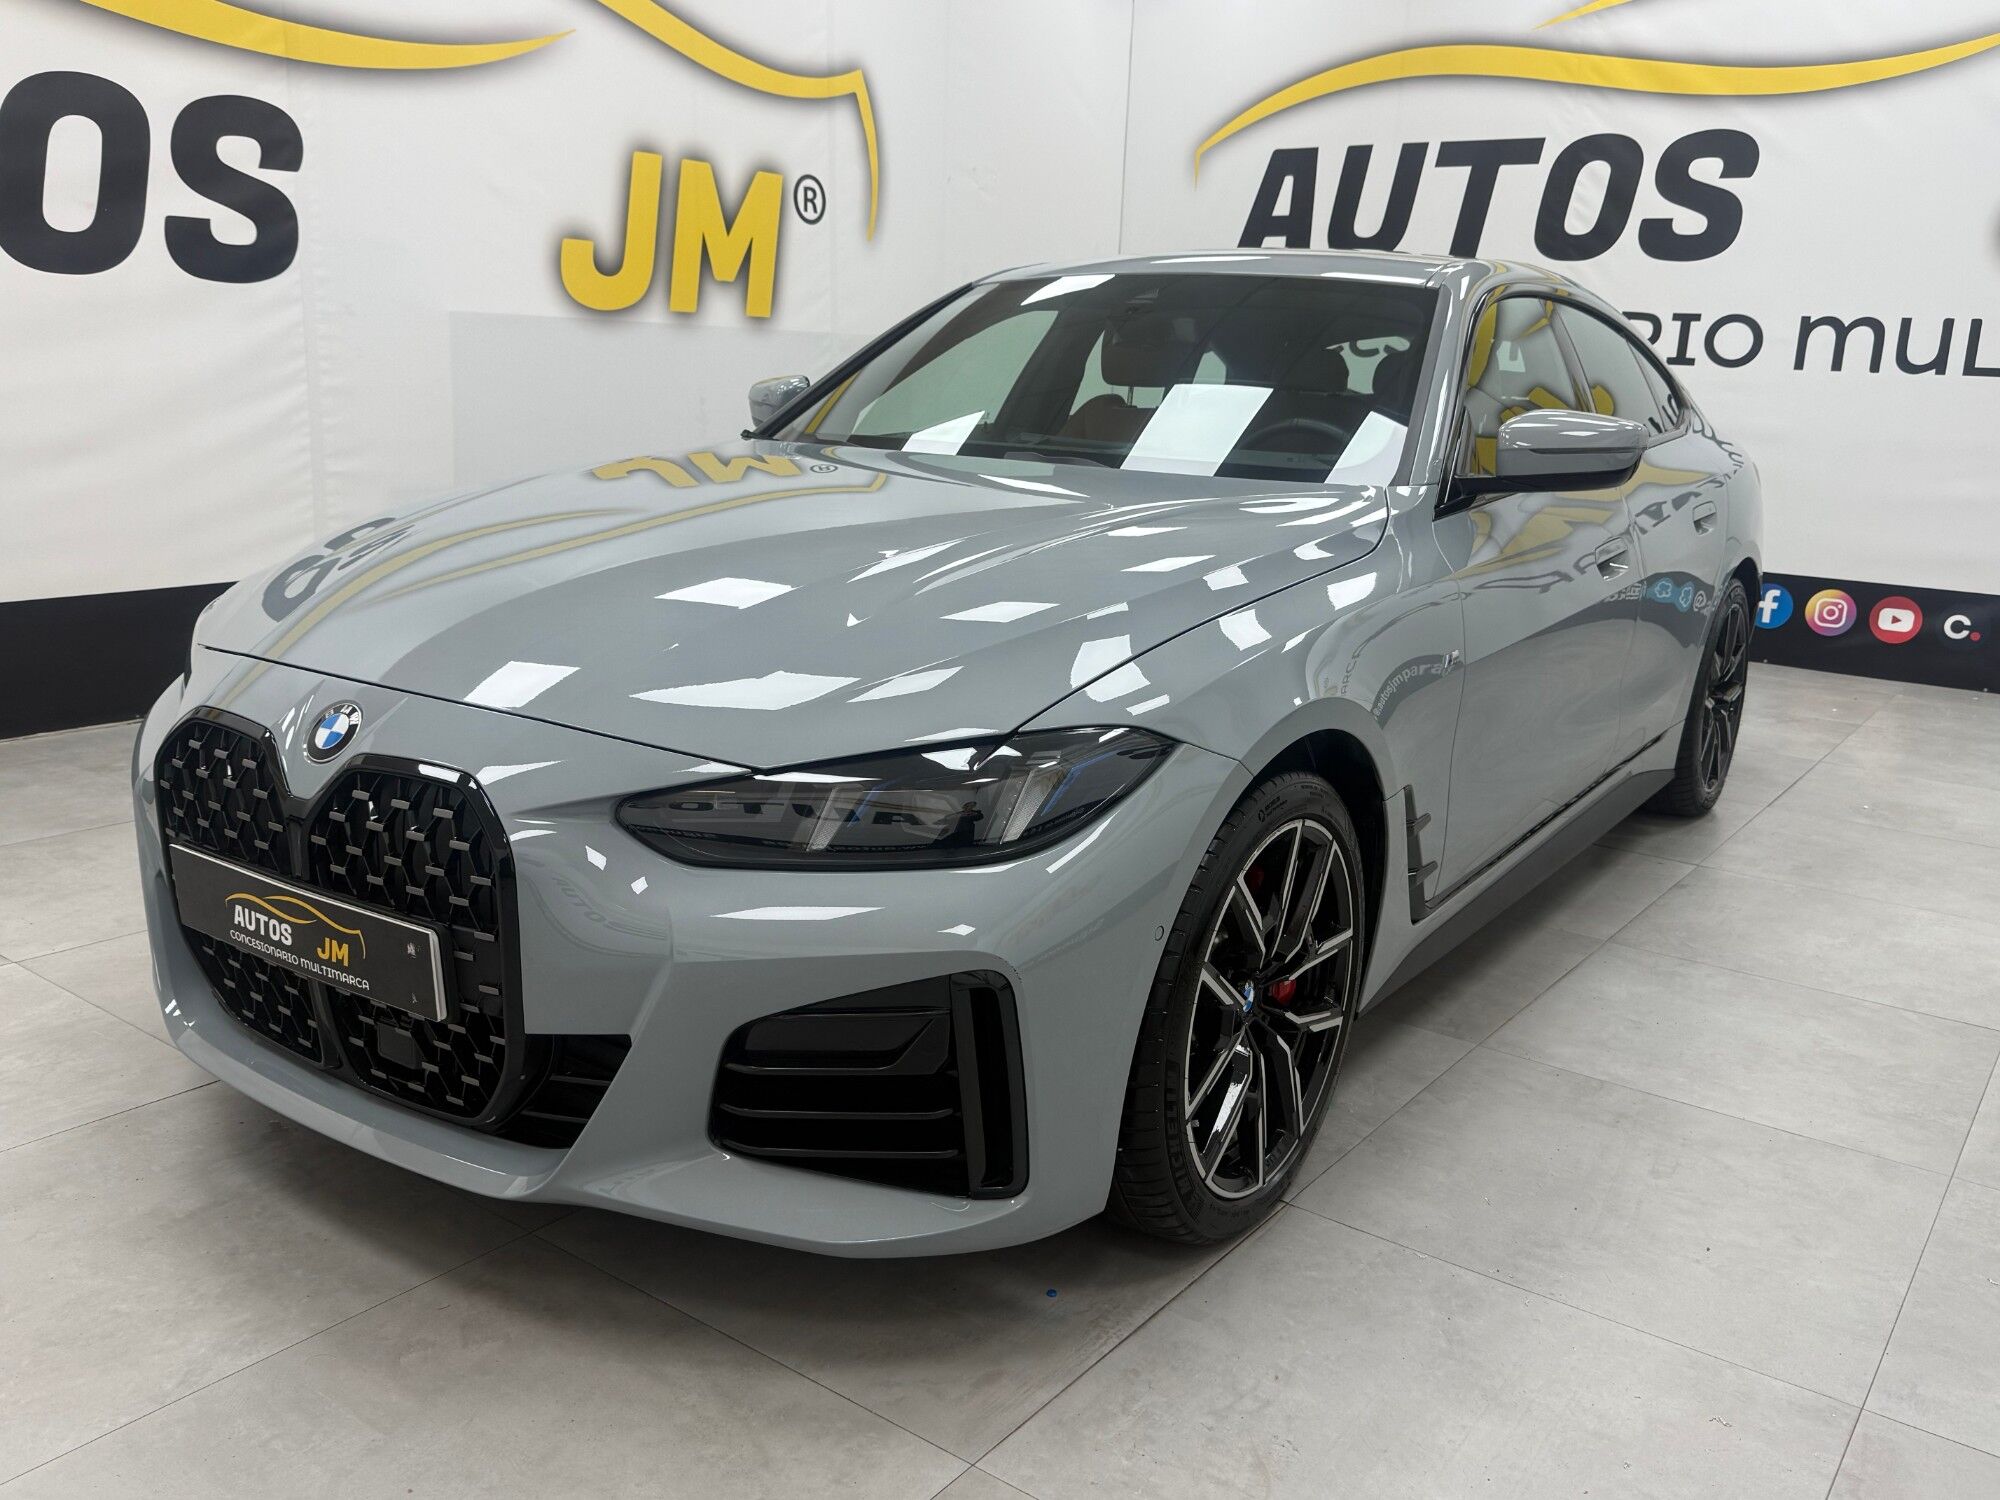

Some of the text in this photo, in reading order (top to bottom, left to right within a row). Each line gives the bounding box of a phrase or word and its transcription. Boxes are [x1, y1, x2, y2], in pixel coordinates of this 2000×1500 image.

[0, 71, 304, 284] OS
[1238, 128, 1760, 263] AUTOS
[233, 904, 293, 946] AUTOS
[317, 937, 349, 967] JM
[229, 929, 370, 991] CONCESIONARIO MULTIMARCA
